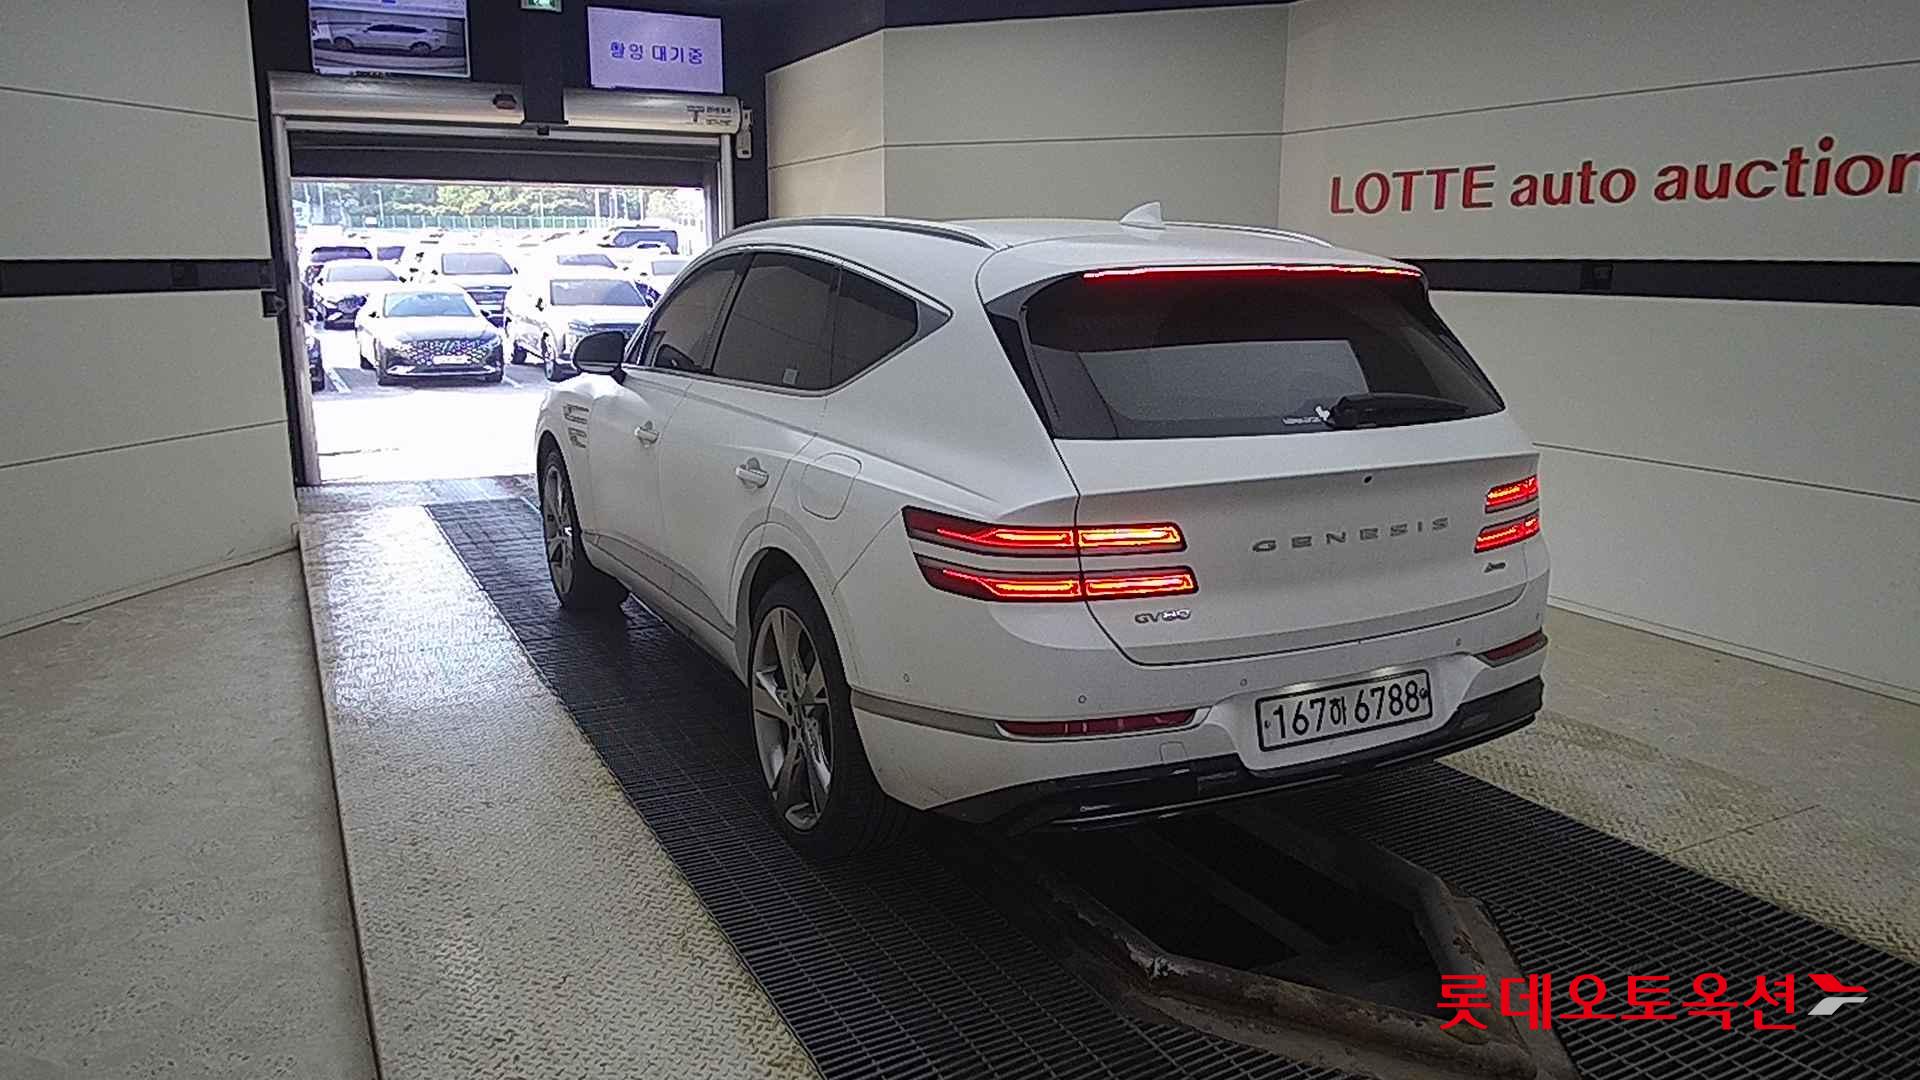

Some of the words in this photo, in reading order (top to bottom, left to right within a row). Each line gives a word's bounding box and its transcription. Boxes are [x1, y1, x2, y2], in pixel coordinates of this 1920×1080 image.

[651, 44, 703, 65] 대기중
[1330, 164, 1497, 215] LOTTE
[1510, 160, 1637, 208] auto
[1252, 517, 1449, 552] GENESIS
[1354, 679, 1420, 724] 6788
